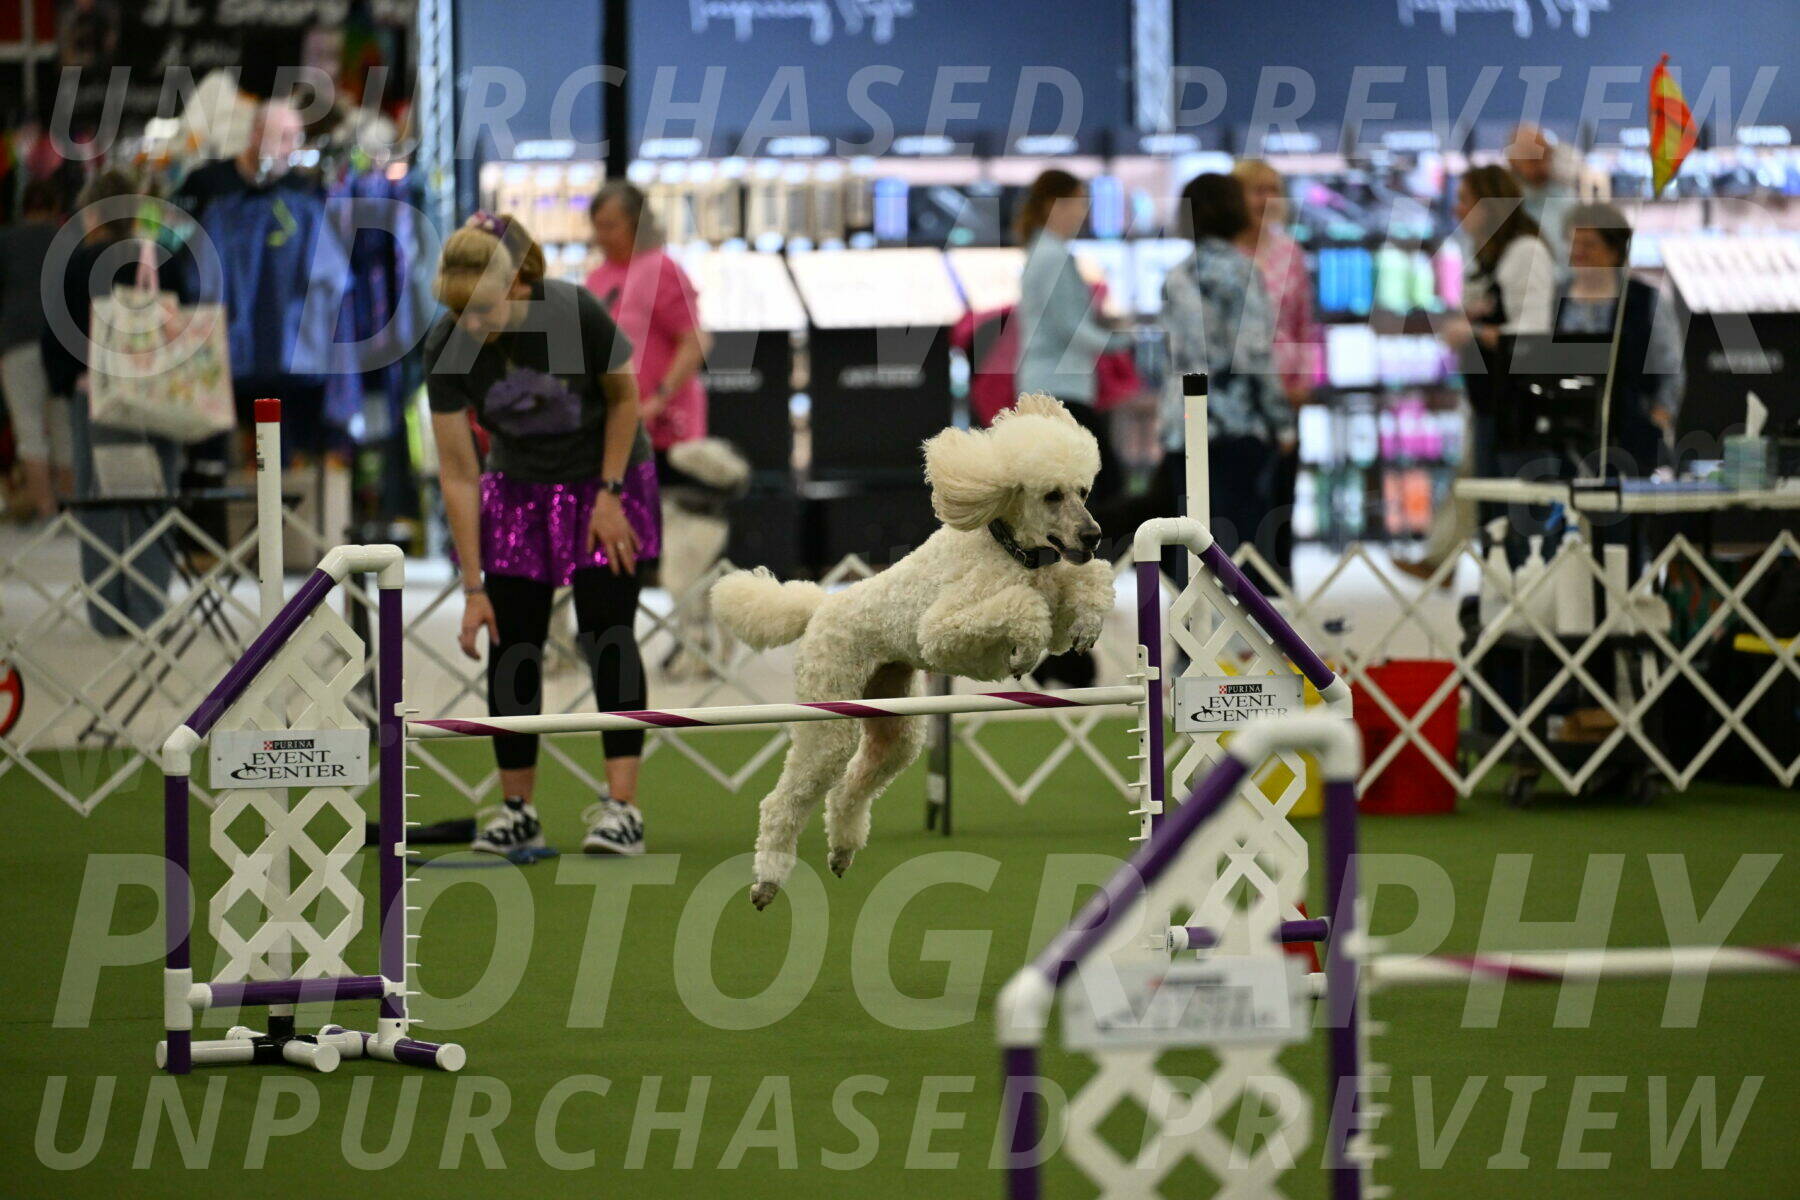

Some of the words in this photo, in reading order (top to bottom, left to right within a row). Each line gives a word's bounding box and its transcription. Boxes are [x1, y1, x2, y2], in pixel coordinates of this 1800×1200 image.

[1227, 684, 1262, 694] PURINA
[1207, 694, 1277, 709] EVENT
[1190, 708, 1288, 722] CENTER
[273, 740, 314, 750] PURINA
[252, 750, 332, 765] EVENT
[230, 765, 347, 780] CENTER
